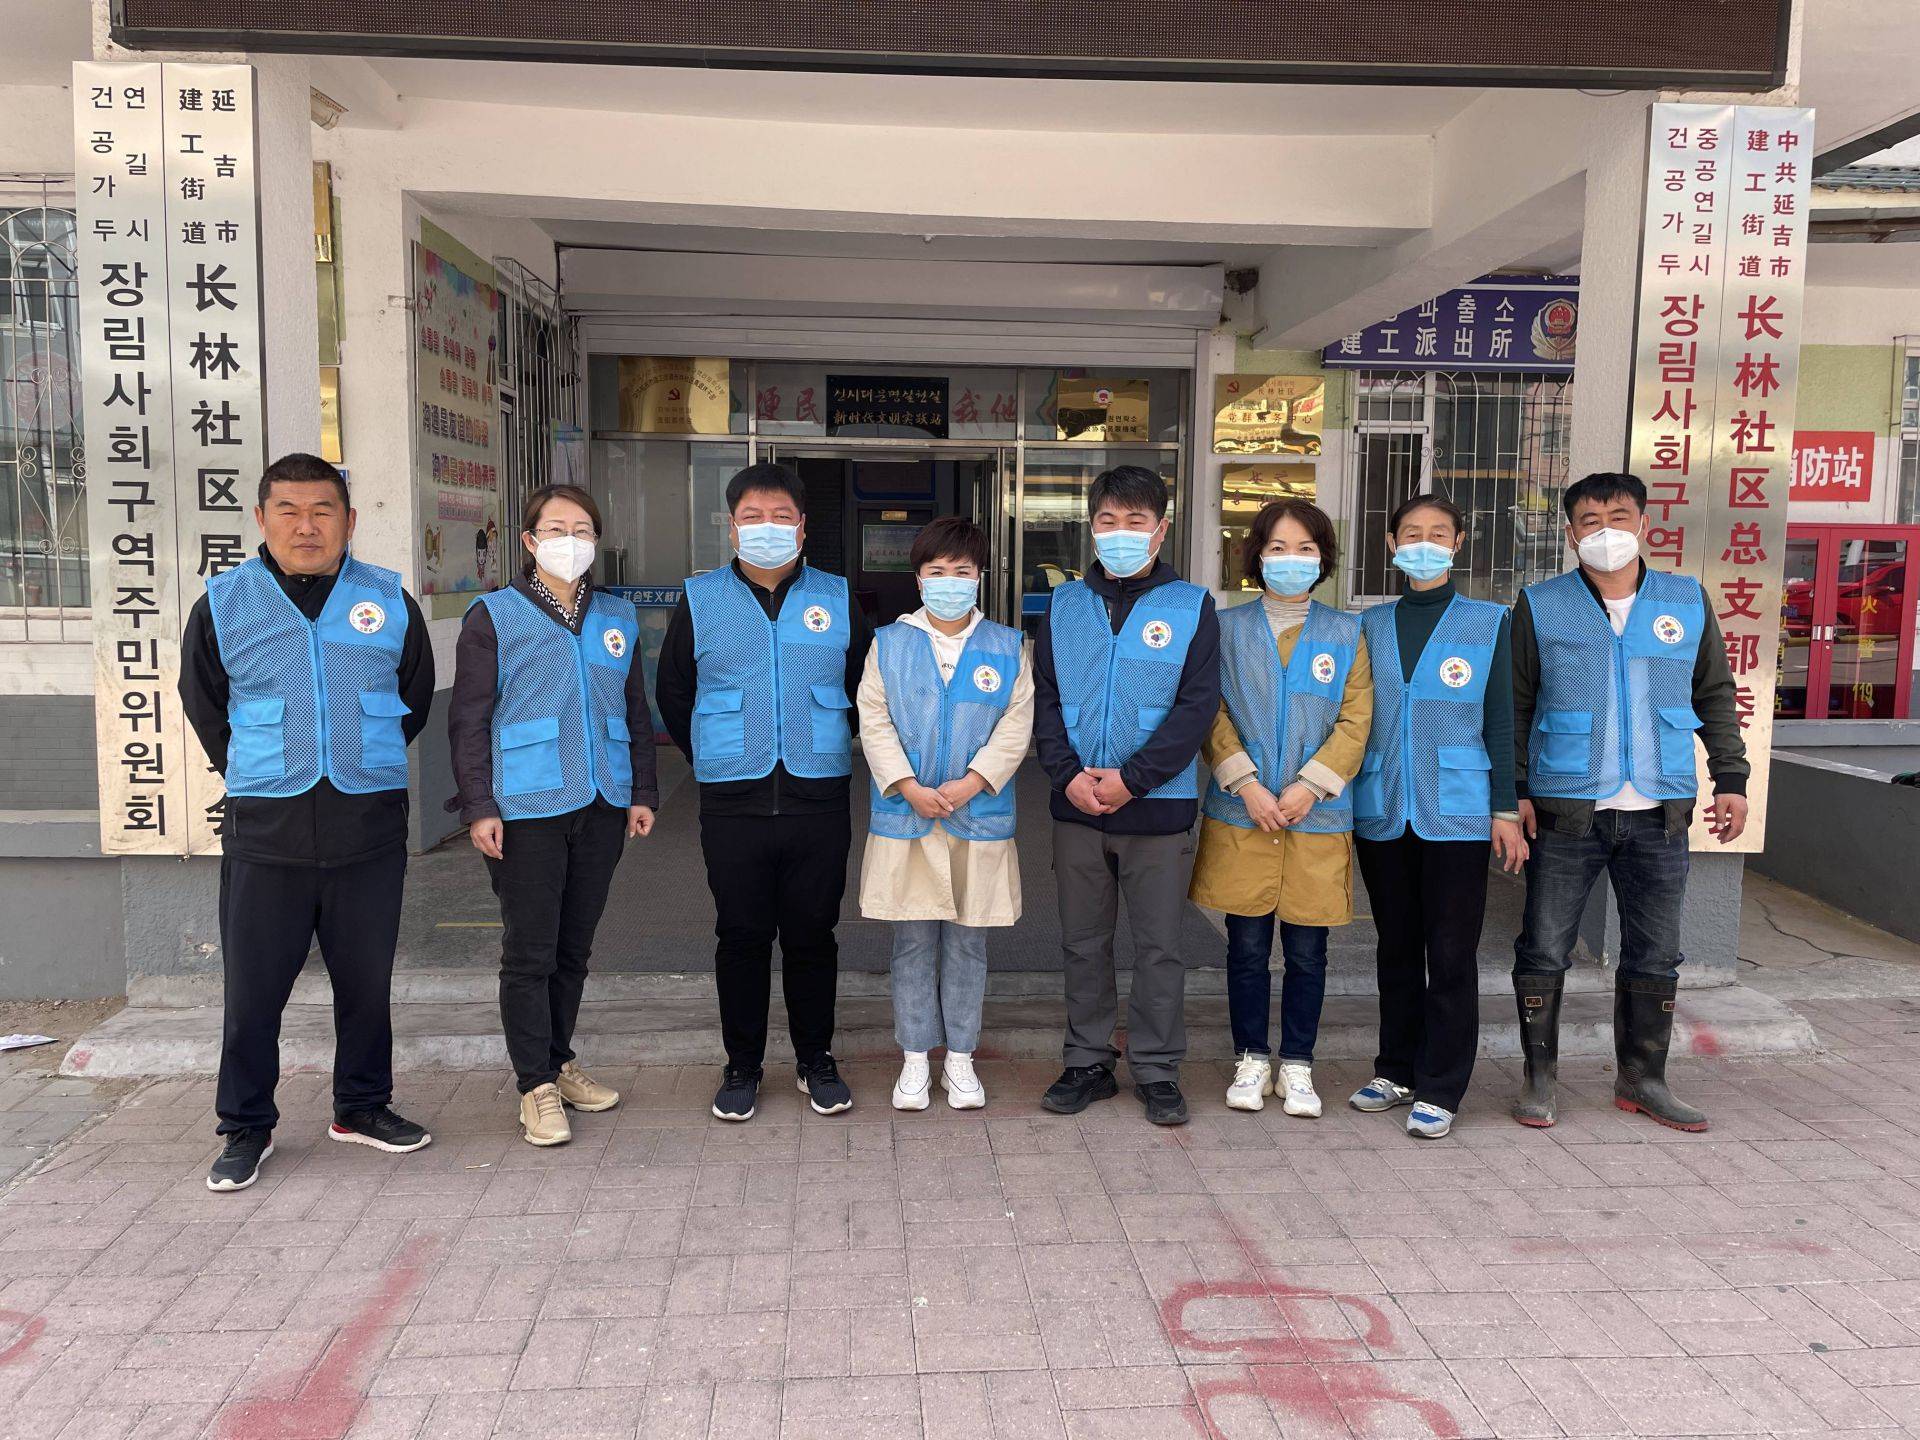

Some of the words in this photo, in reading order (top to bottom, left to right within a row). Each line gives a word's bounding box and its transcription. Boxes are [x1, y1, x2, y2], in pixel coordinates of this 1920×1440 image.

[90, 86, 117, 243] 건공가두
[123, 87, 149, 242] 연길시
[179, 88, 207, 244] 建工街道
[211, 89, 239, 244] 延吉市
[1658, 127, 1688, 276] 건공가두
[1689, 128, 1719, 276] 중공연길시
[1738, 129, 1770, 278] 建工街道
[1769, 130, 1799, 278] 中共延吉市
[833, 408, 942, 425] 新时代文明实践站
[1339, 326, 1514, 359] 建工派出所
[1645, 294, 1704, 574] 장림사회구역
[99, 262, 166, 836] 장림사회구역주민위원회
[1852, 681, 1874, 702] 119
[1857, 594, 1878, 659] 火警
